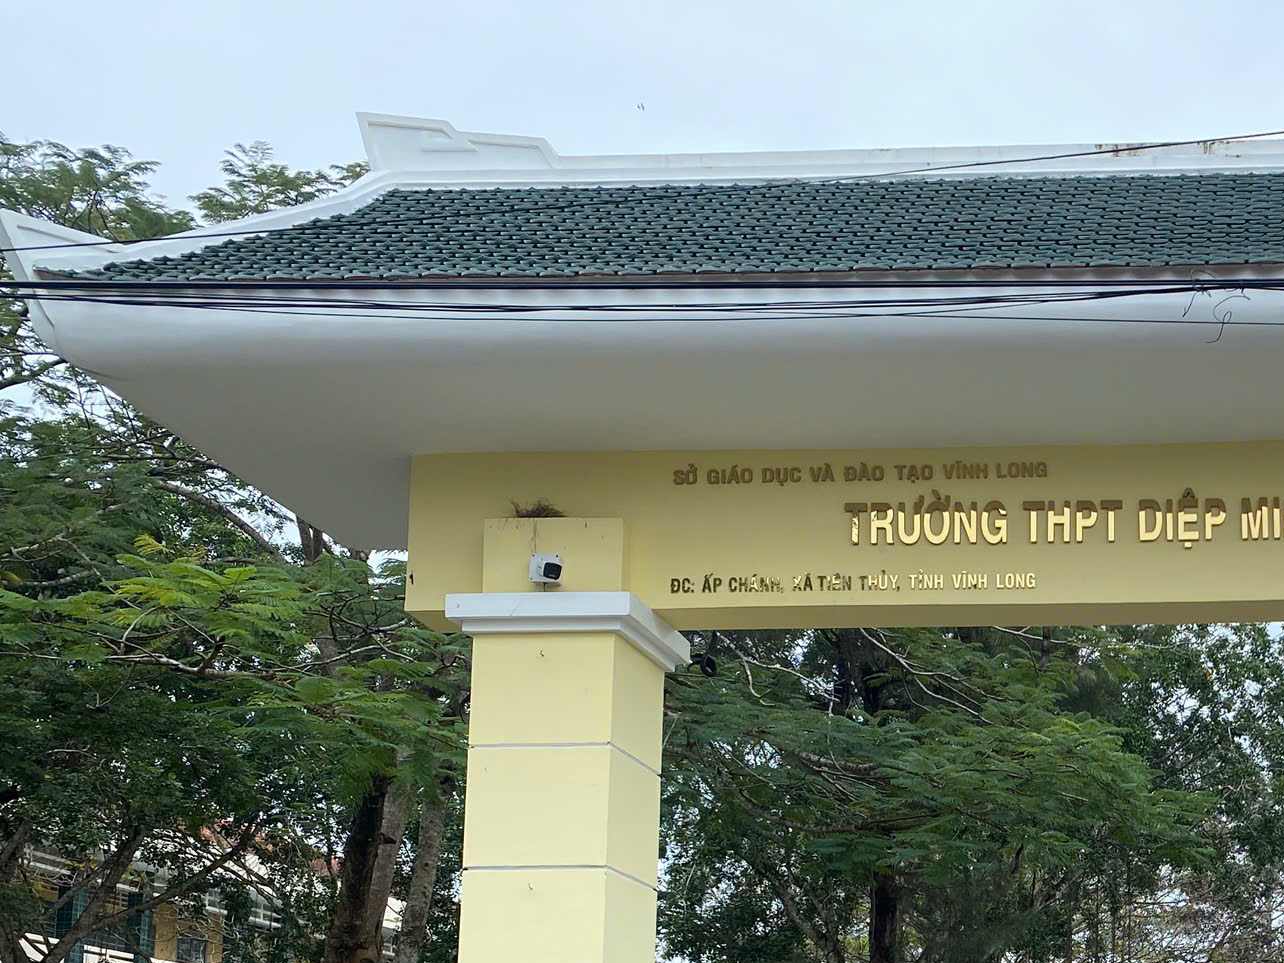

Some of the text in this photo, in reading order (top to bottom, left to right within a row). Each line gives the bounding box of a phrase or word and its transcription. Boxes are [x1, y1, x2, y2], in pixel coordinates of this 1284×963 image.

[673, 461, 1048, 486] SỞ GIÁO DỤC VÀ ĐÀO TẠO VĨNH LONG
[845, 489, 1008, 545] TRƯỜNG
[1023, 499, 1123, 543] THPT
[1138, 487, 1226, 549] DIỆP
[702, 573, 722, 593] ẤP
[792, 574, 813, 592] XÃ
[859, 569, 901, 592] THỦY,
[909, 569, 944, 590] TỈNH
[952, 571, 989, 590] VĨNH
[996, 573, 1037, 590] LONG
